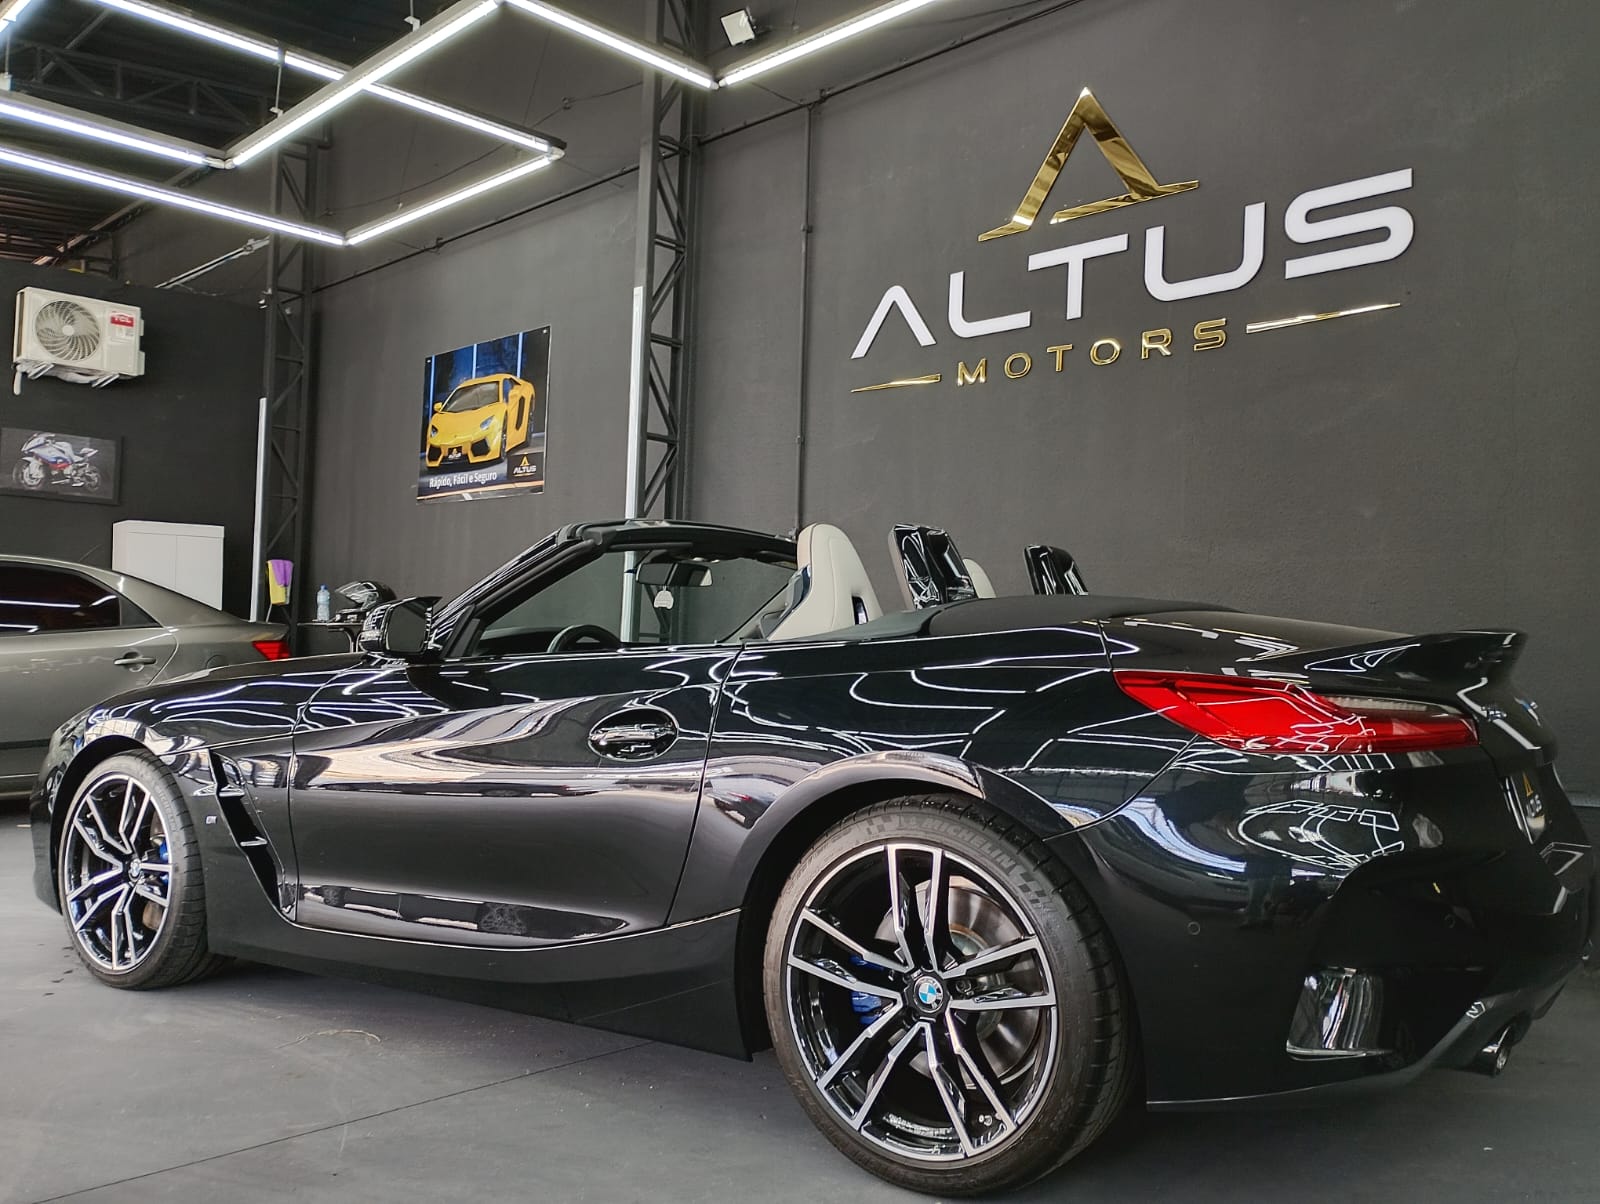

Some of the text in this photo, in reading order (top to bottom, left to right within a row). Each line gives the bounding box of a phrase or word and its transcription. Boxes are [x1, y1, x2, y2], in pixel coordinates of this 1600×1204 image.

[851, 167, 1415, 360] ALTUS
[957, 317, 1227, 386] MOTORS
[474, 472, 497, 484] Seguro
[513, 465, 537, 474] ALTUS
[922, 818, 1016, 871] MICHELIN
